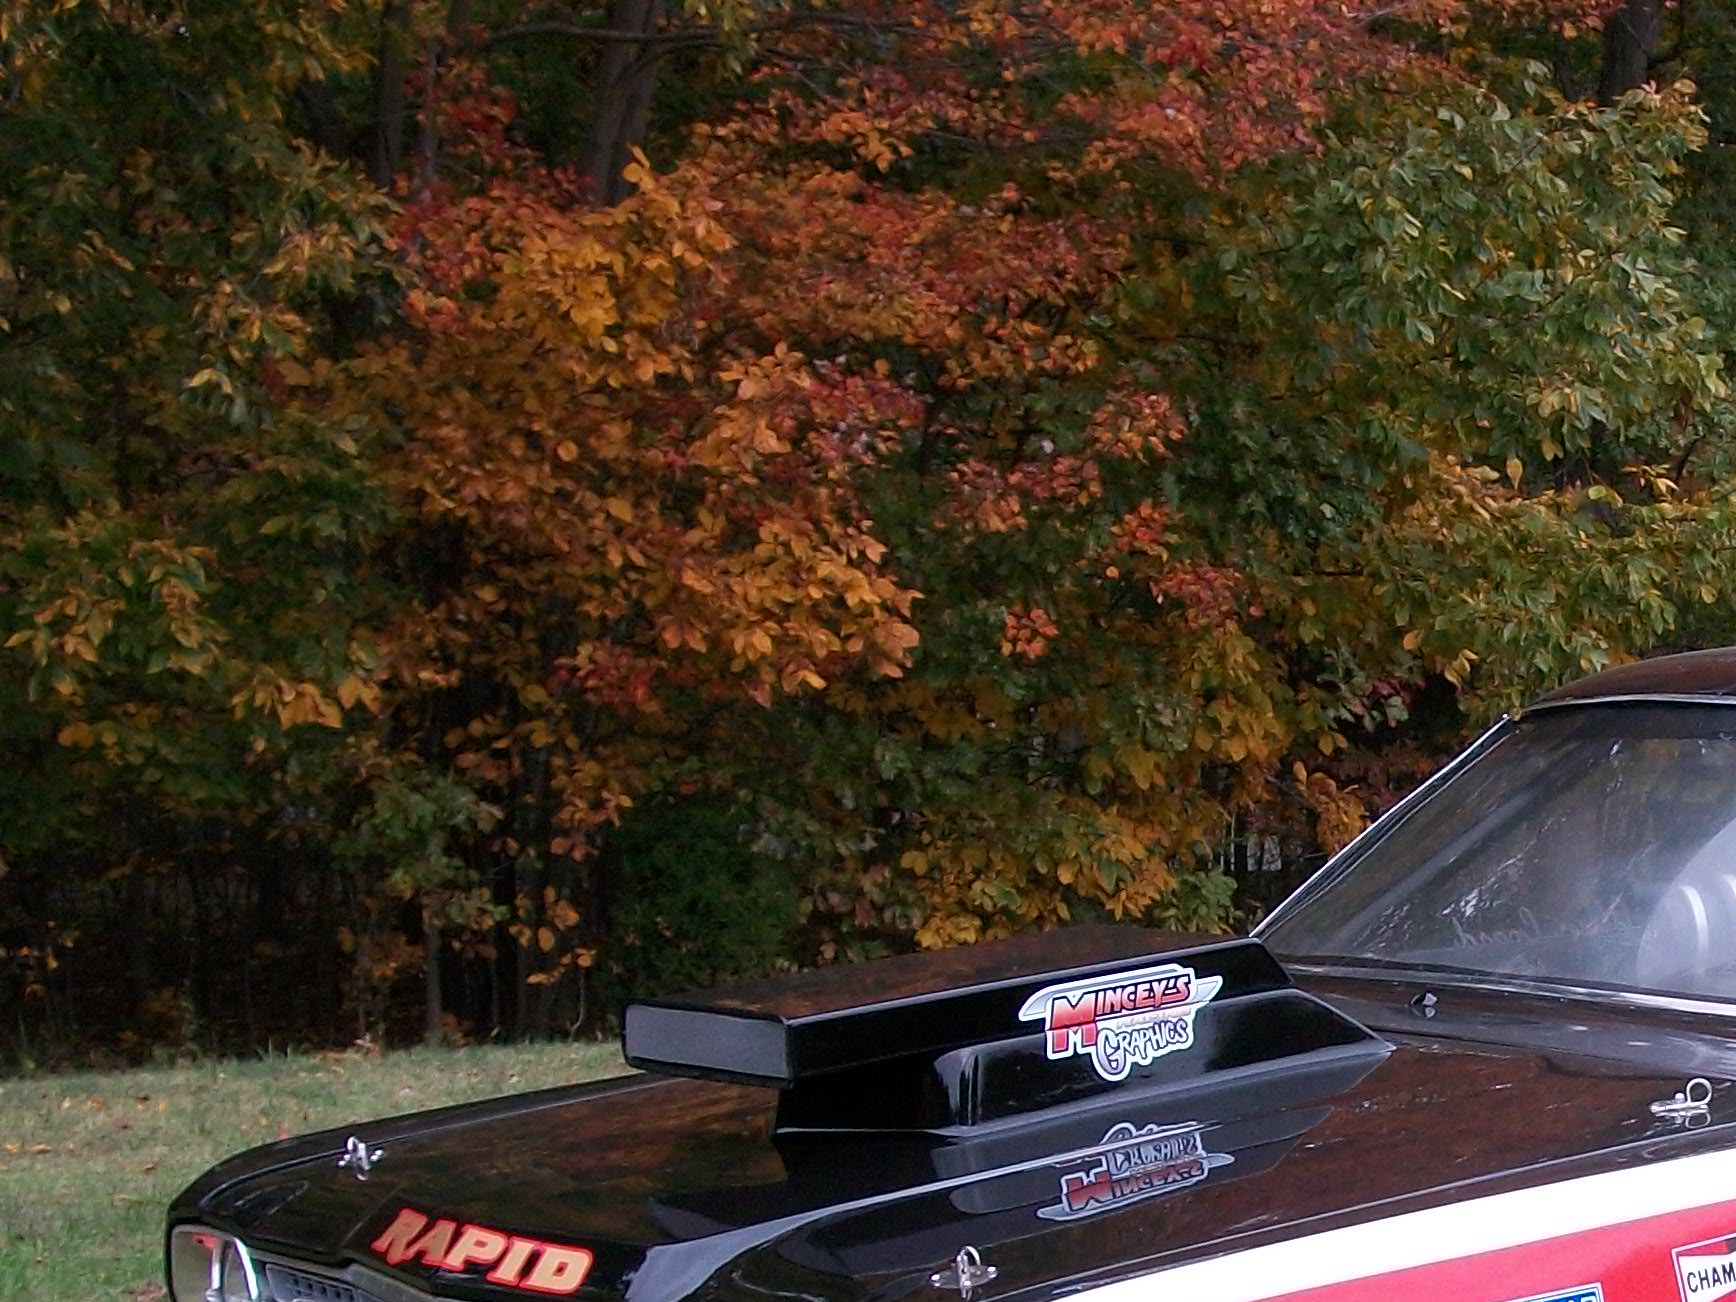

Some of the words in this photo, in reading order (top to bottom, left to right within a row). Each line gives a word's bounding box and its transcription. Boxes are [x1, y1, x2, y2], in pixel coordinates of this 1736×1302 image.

[1050, 974, 1191, 1053] MINCEY'S
[1096, 1018, 1189, 1075] GRAPHICS
[371, 1207, 593, 1295] RAPID
